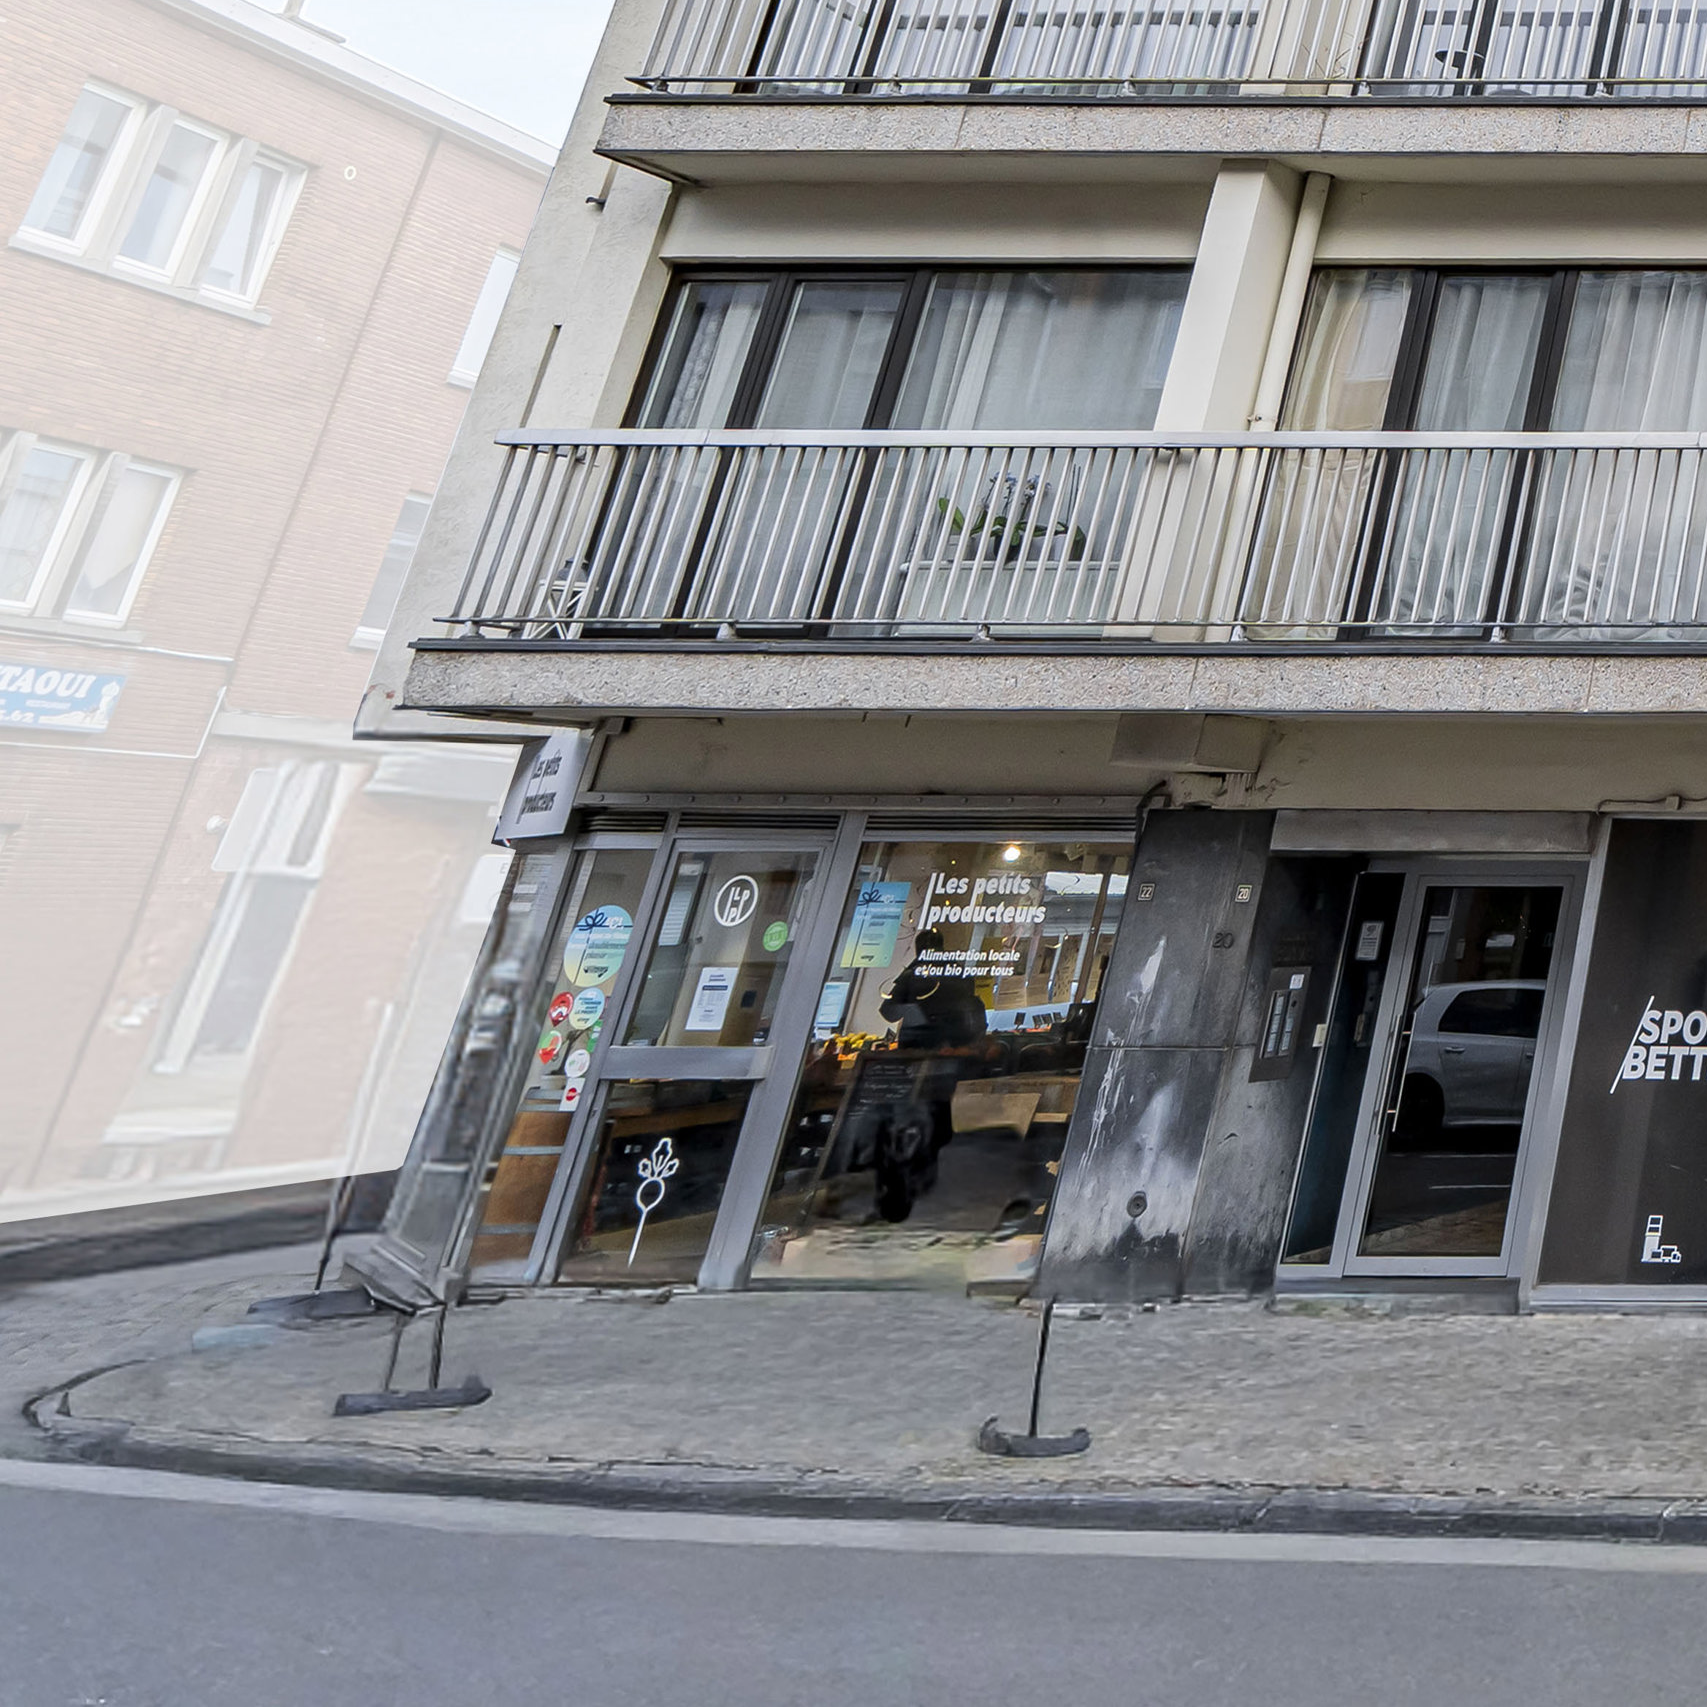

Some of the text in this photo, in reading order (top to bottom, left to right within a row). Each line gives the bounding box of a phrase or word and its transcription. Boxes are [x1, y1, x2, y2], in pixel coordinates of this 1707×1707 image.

[0, 664, 97, 699] TAOUI
[934, 872, 1032, 908] Les petits
[1140, 886, 1153, 898] 22
[1238, 888, 1249, 900] 20
[925, 901, 1047, 930] producteurs
[1212, 932, 1235, 949] 20
[918, 948, 1021, 962] Alimentation locale
[914, 963, 1015, 979] et/ou bio pour tous
